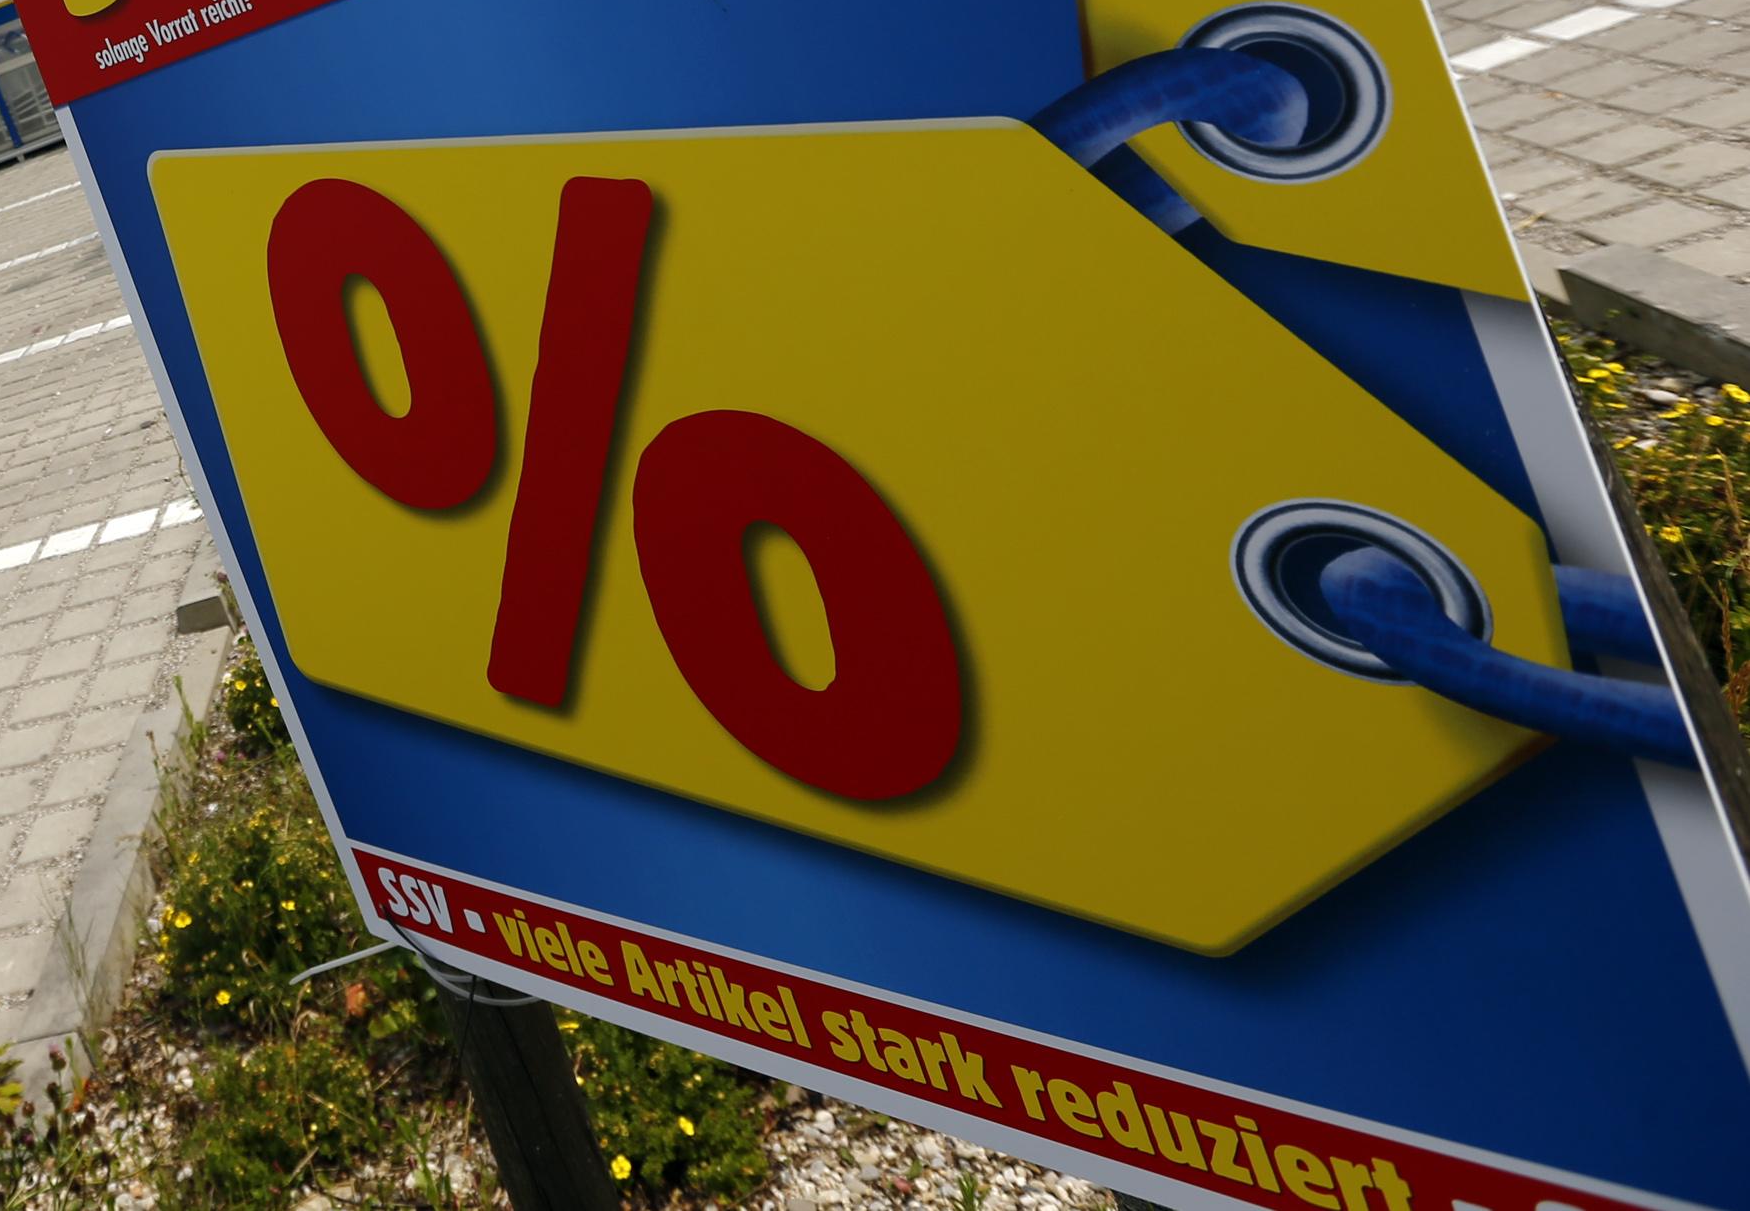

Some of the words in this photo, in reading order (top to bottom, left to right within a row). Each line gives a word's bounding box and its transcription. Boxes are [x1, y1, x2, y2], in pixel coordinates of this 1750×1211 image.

[95, 37, 150, 70] solange
[145, 7, 200, 47] Vorrat
[376, 866, 455, 934] SSV
[492, 910, 615, 987] viele
[620, 940, 813, 1050] Artikel
[820, 1009, 1004, 1110] stark
[1009, 1063, 1414, 1211] reduziert
